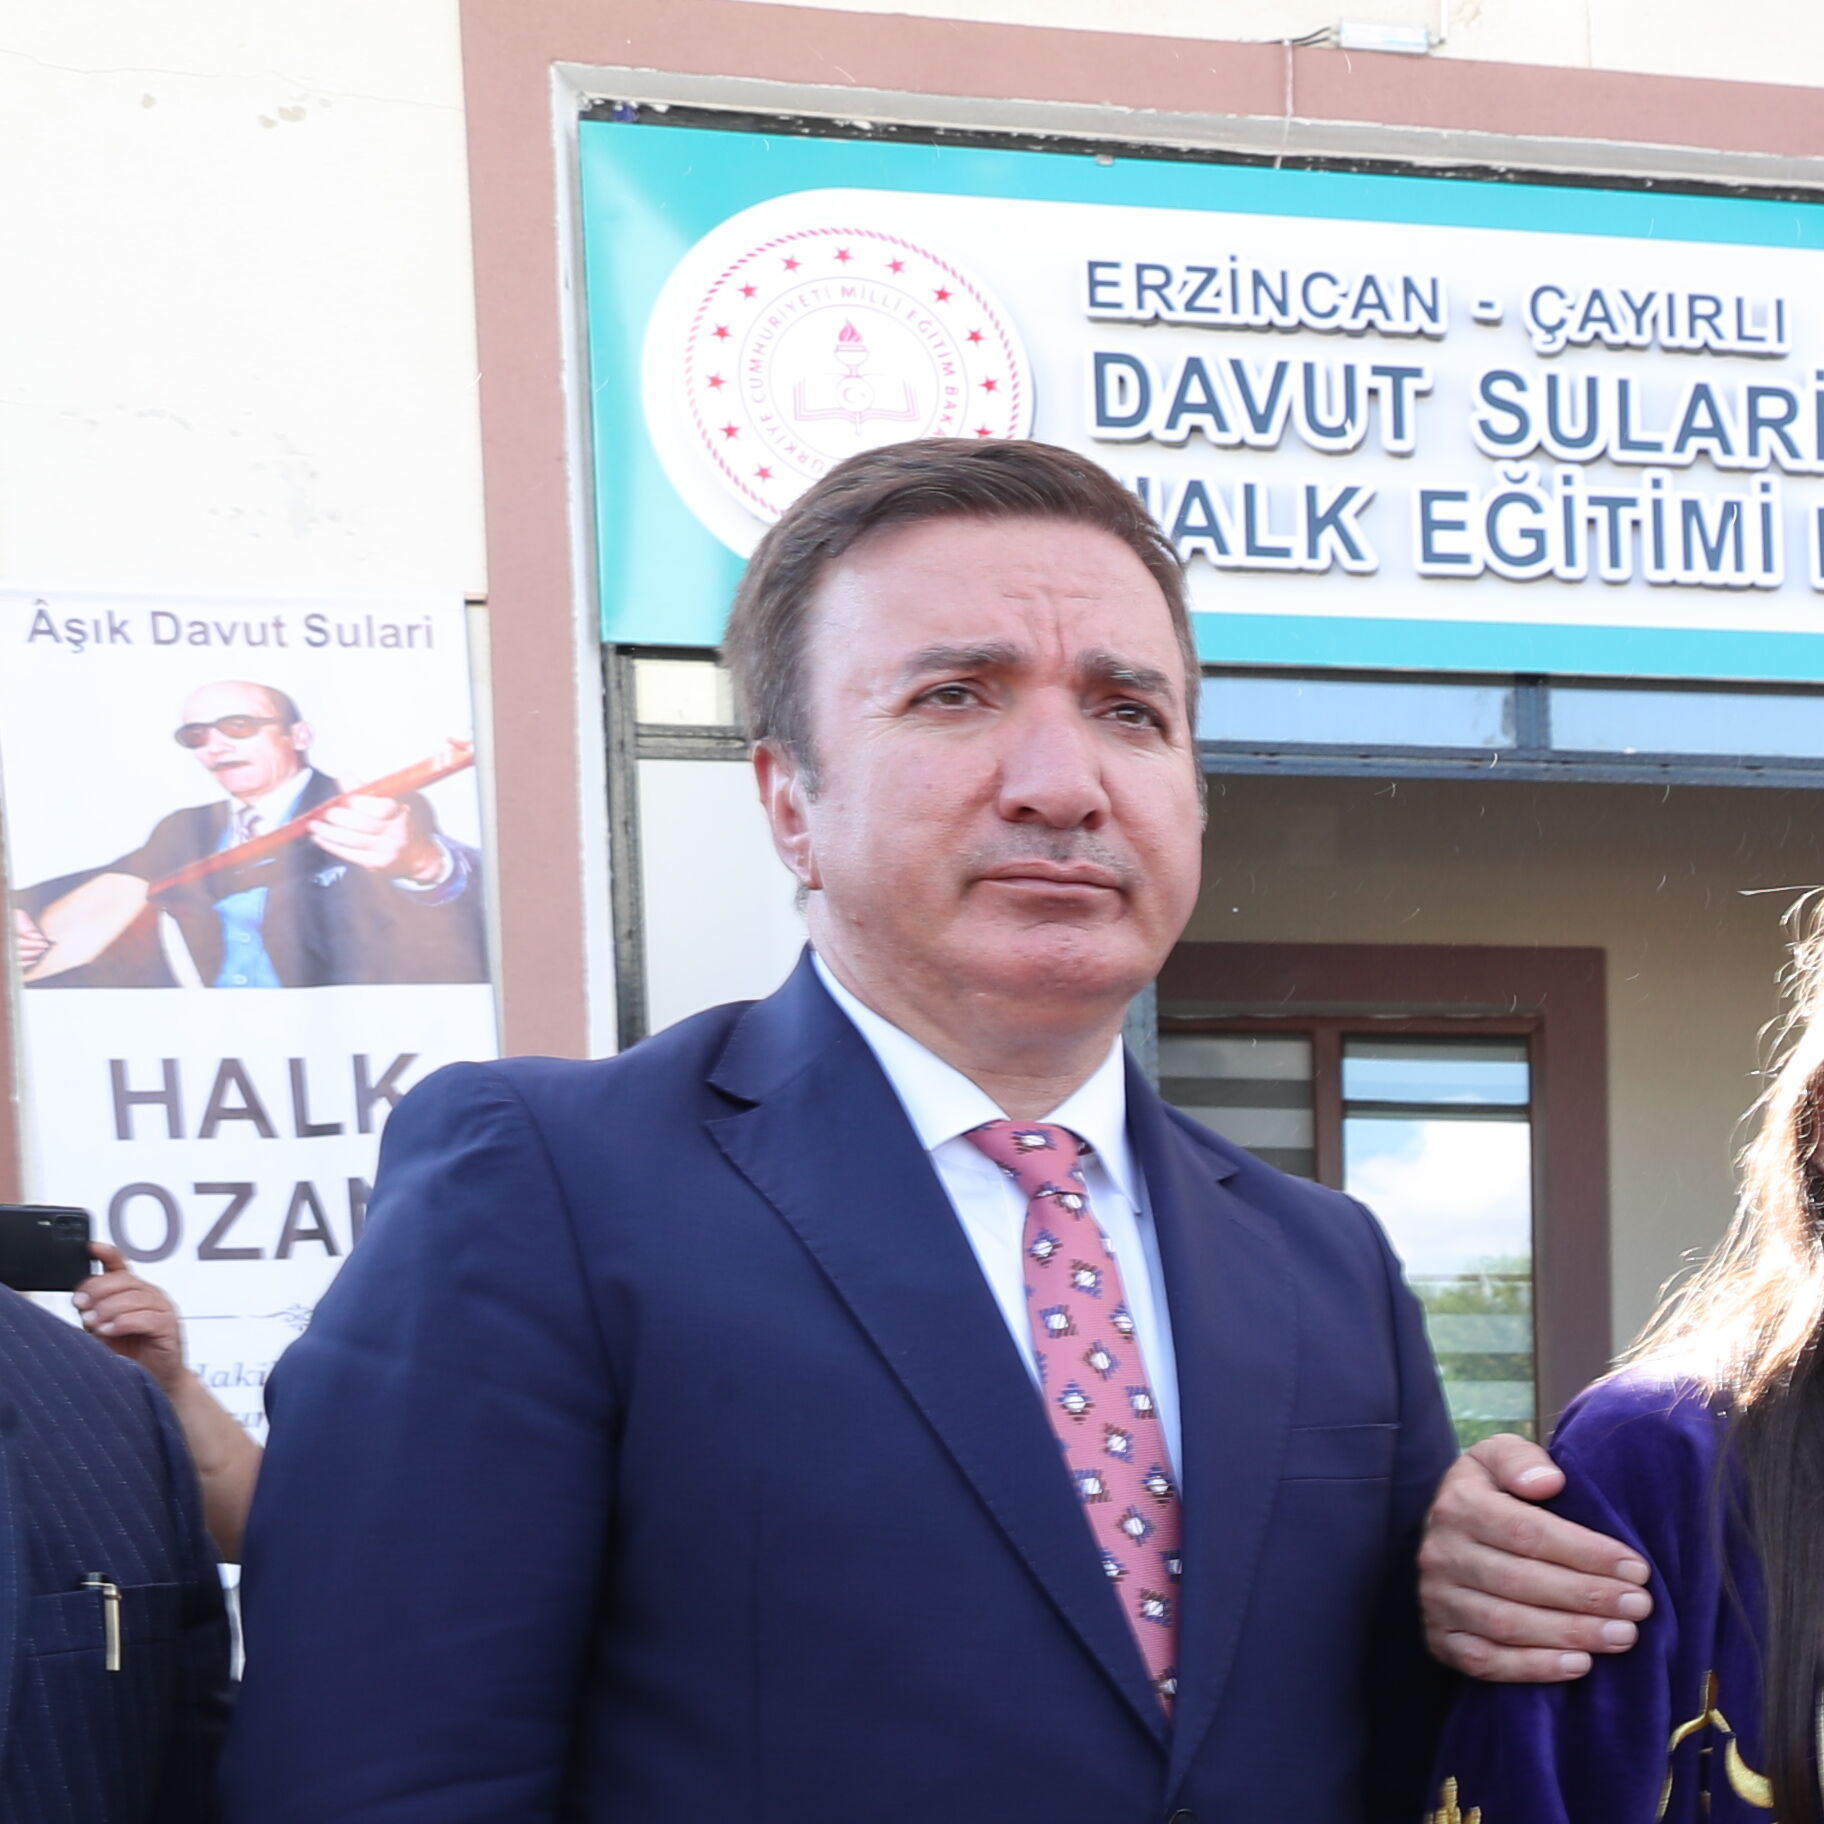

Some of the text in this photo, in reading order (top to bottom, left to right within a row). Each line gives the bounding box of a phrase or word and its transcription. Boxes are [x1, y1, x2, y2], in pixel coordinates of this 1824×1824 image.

[1087, 254, 1440, 324] ERZİNCAN
[1530, 285, 1785, 345] ÇAYIRLI
[1093, 352, 1424, 441] DAVUT
[1136, 476, 1369, 562] ALK
[1418, 472, 1775, 575] EĞİTİMİ
[27, 598, 436, 654] Âşık Davut Sulari
